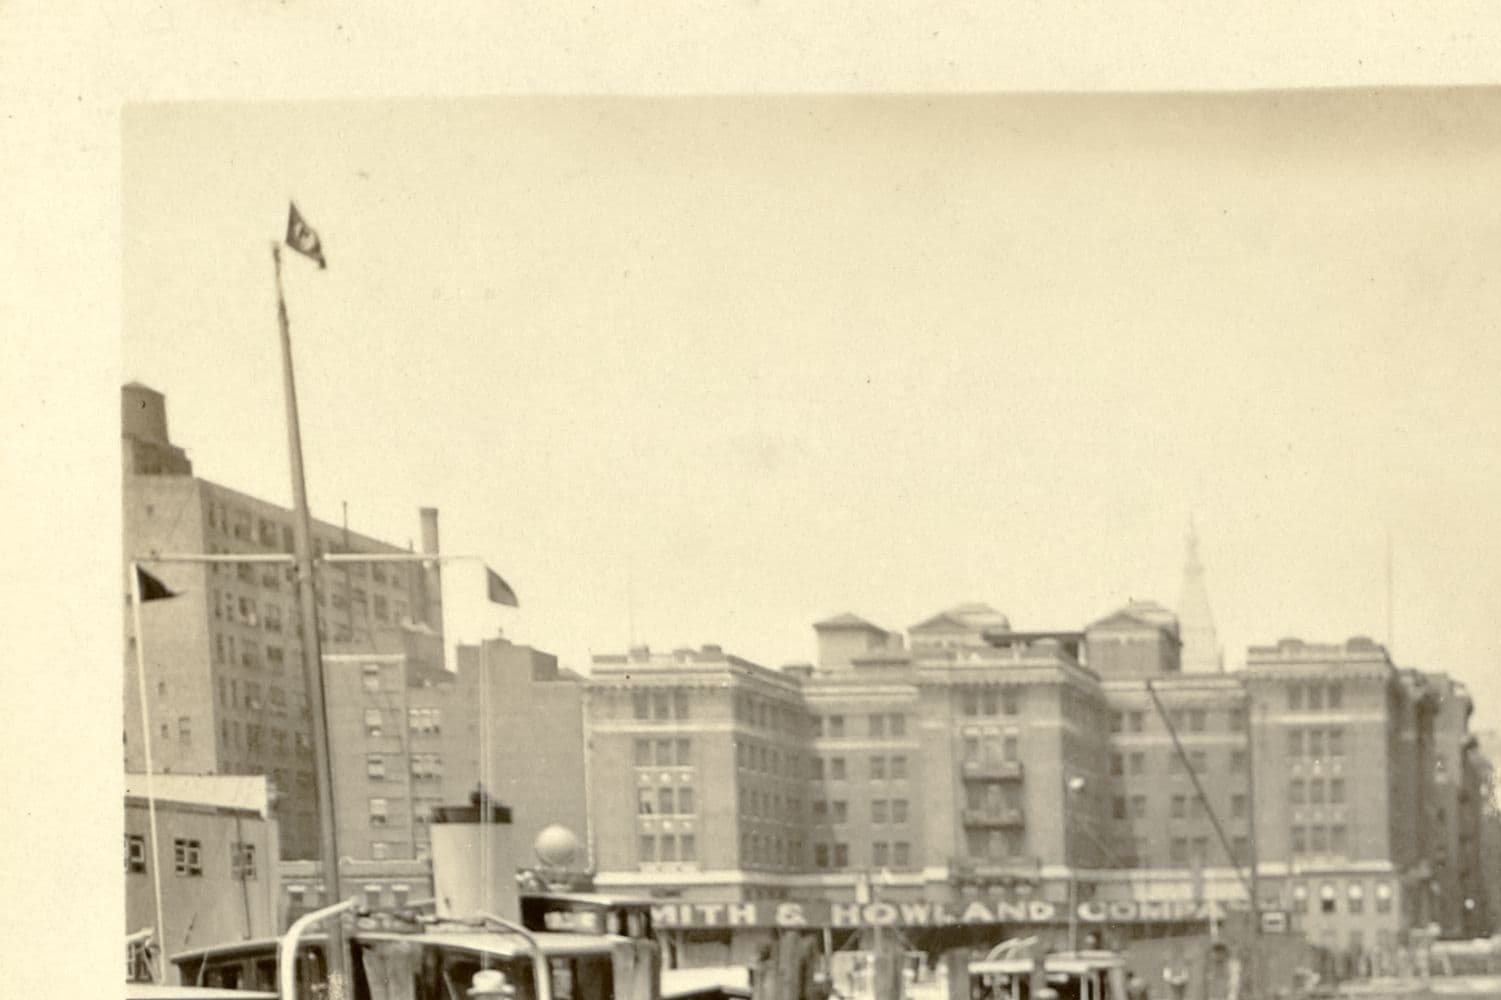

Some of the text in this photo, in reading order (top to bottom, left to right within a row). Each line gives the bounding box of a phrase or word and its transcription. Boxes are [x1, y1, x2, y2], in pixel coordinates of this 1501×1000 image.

[650, 903, 756, 926] MITH
[776, 903, 807, 926] &
[832, 901, 1054, 926] HOWLAND
